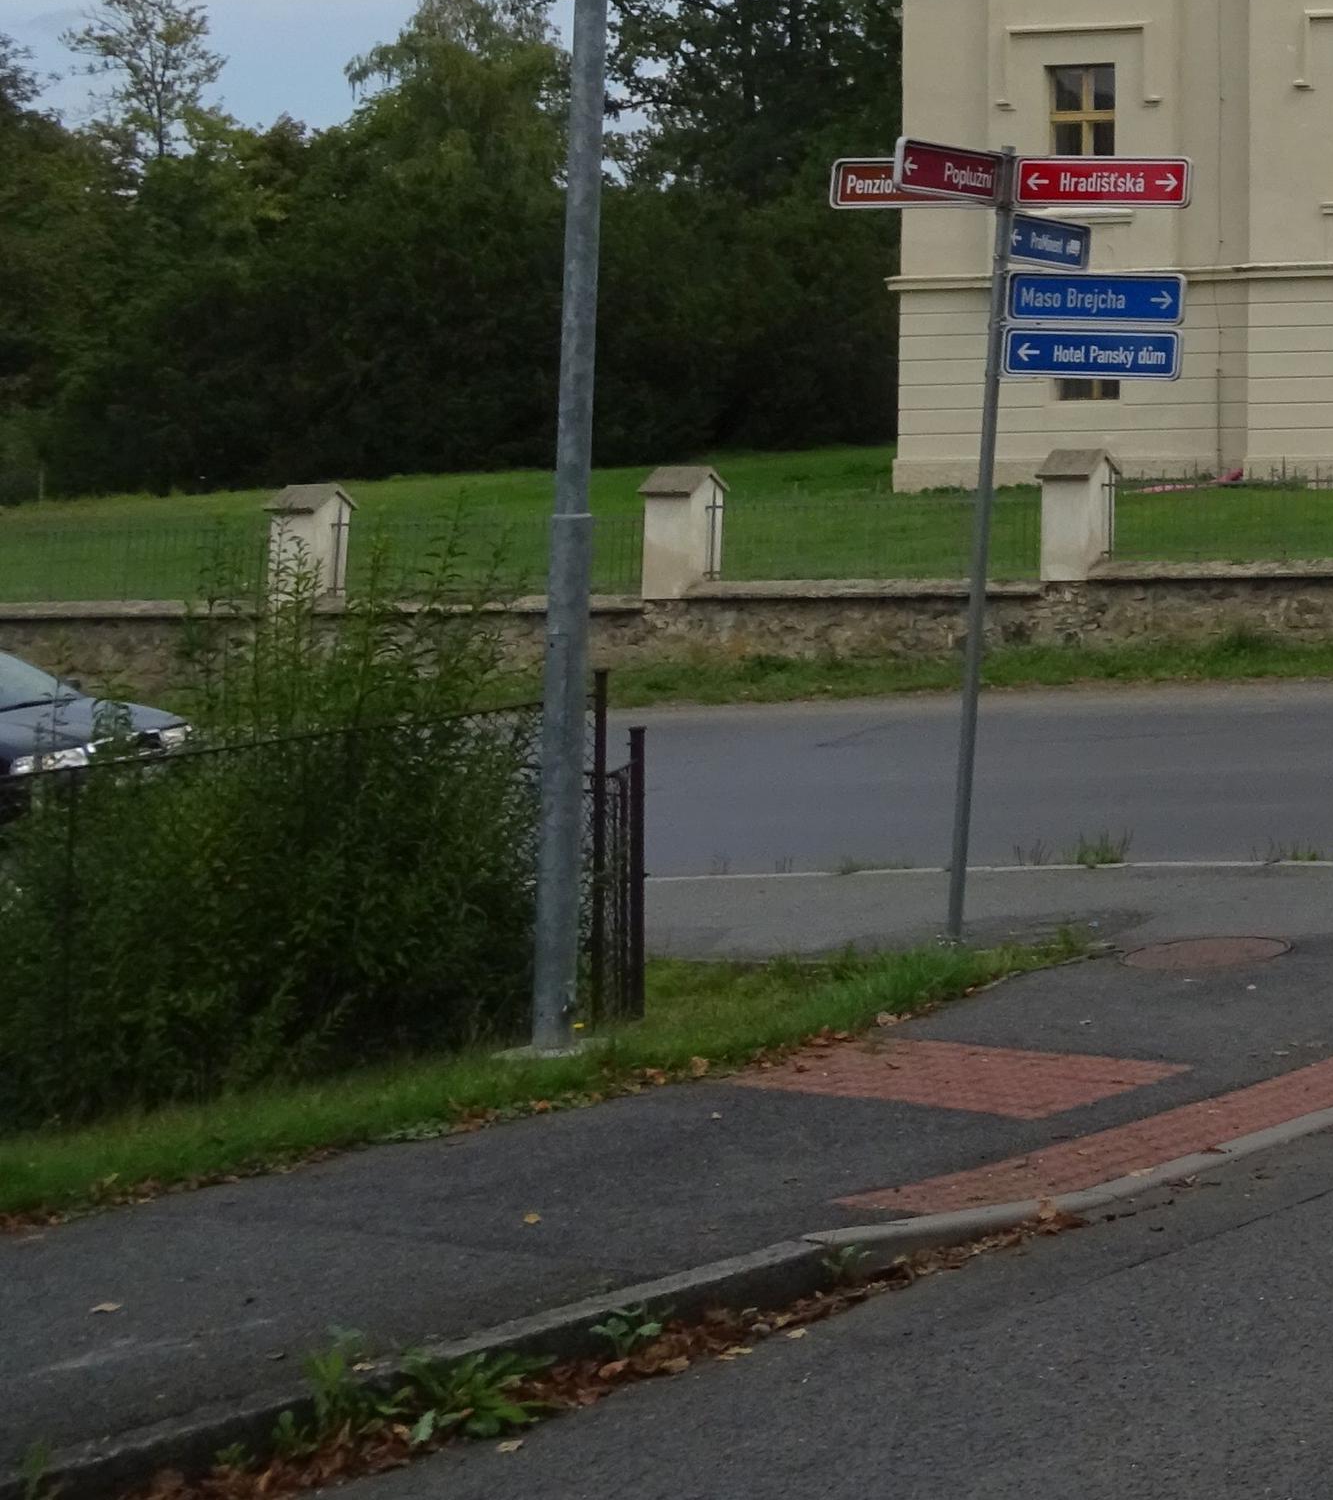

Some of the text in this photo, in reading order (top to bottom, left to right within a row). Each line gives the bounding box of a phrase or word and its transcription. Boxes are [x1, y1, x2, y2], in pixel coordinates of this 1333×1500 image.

[846, 174, 897, 195] Penzio
[944, 161, 994, 189] Poplužní
[1059, 172, 1145, 193] Hradišťská
[1021, 287, 1126, 313] Maso Brejcha
[1053, 345, 1166, 368] Hotel Panský dům
